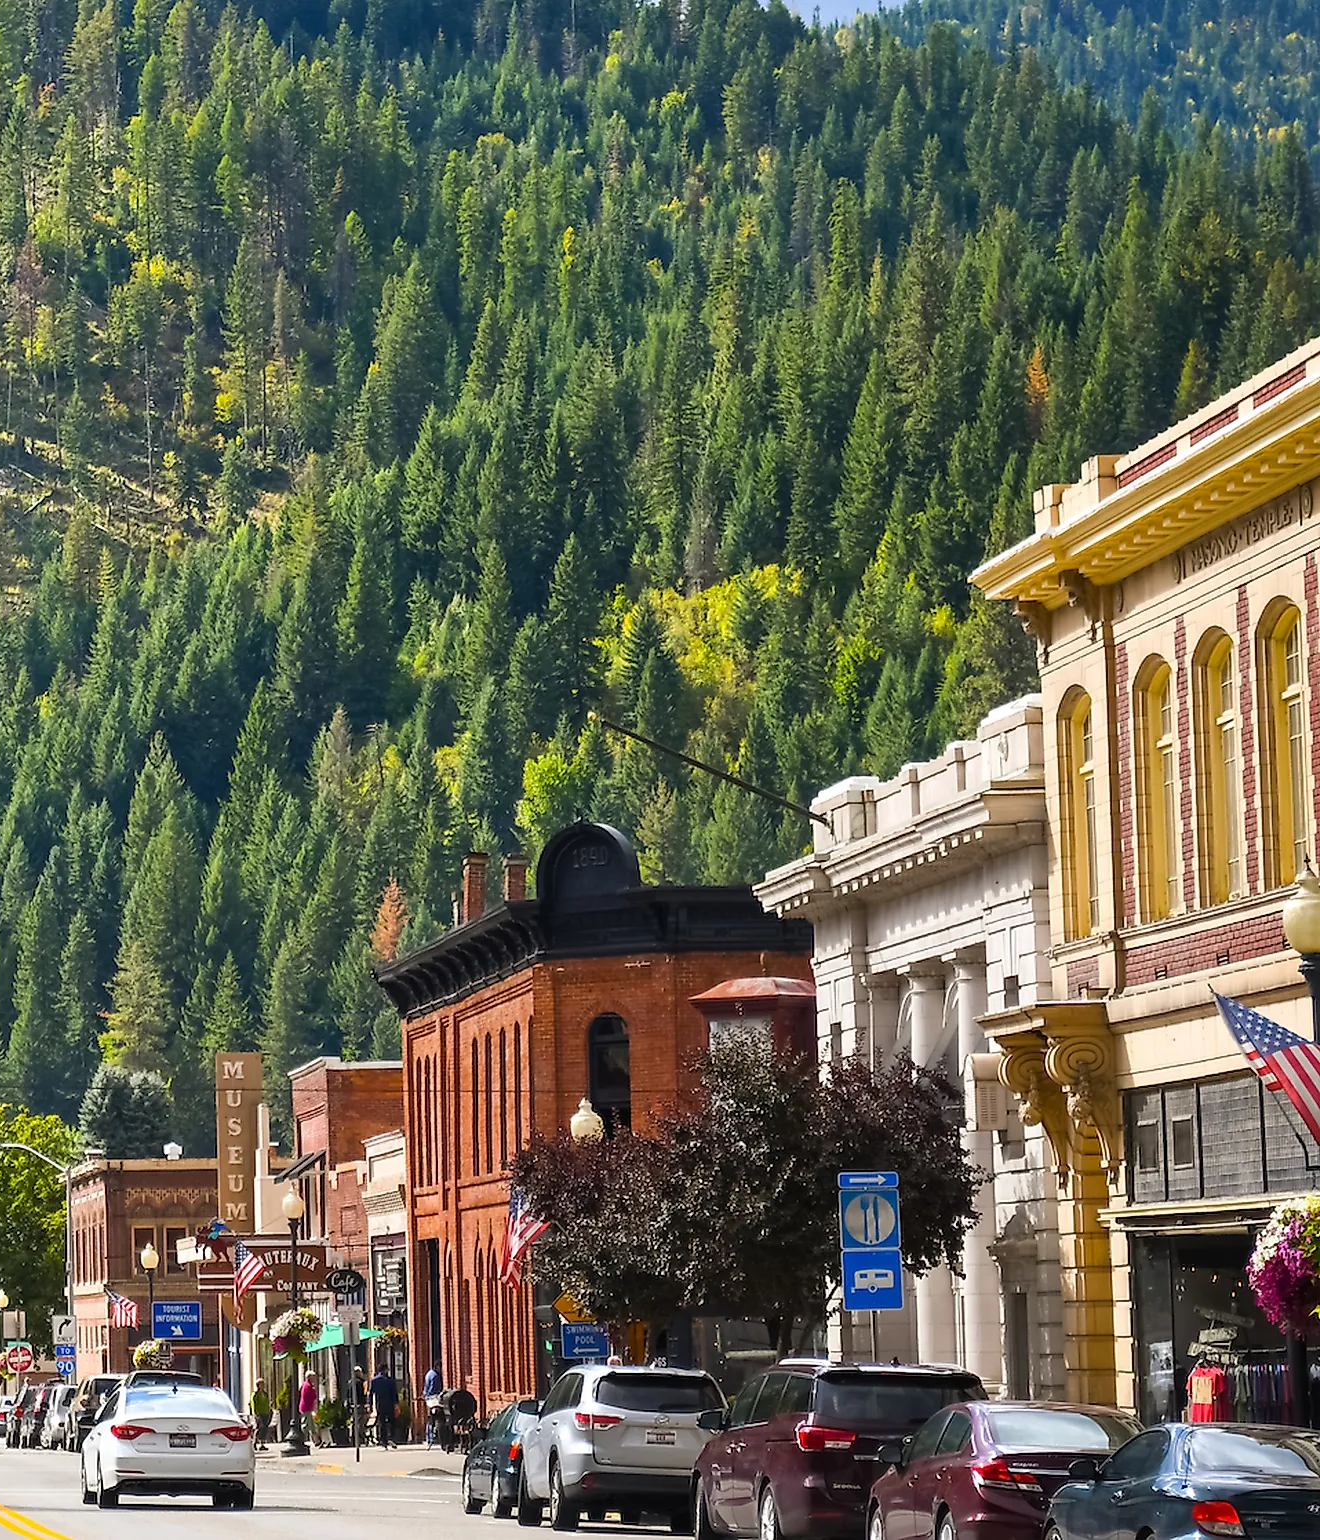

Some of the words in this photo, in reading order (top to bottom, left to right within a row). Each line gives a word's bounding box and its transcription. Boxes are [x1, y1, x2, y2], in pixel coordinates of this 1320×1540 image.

[1190, 529, 1238, 573] MASONIC
[1243, 501, 1293, 546] TEMPLE
[572, 846, 609, 868] 1890
[222, 1060, 248, 1221] MUSEUM
[162, 1305, 191, 1313] TOURIST
[155, 1314, 198, 1323] INFORMATION
[566, 1326, 606, 1335] SWIMMIN
[575, 1335, 596, 1345] POOL
[60, 1346, 71, 1355] TO
[56, 1360, 75, 1373] 90
